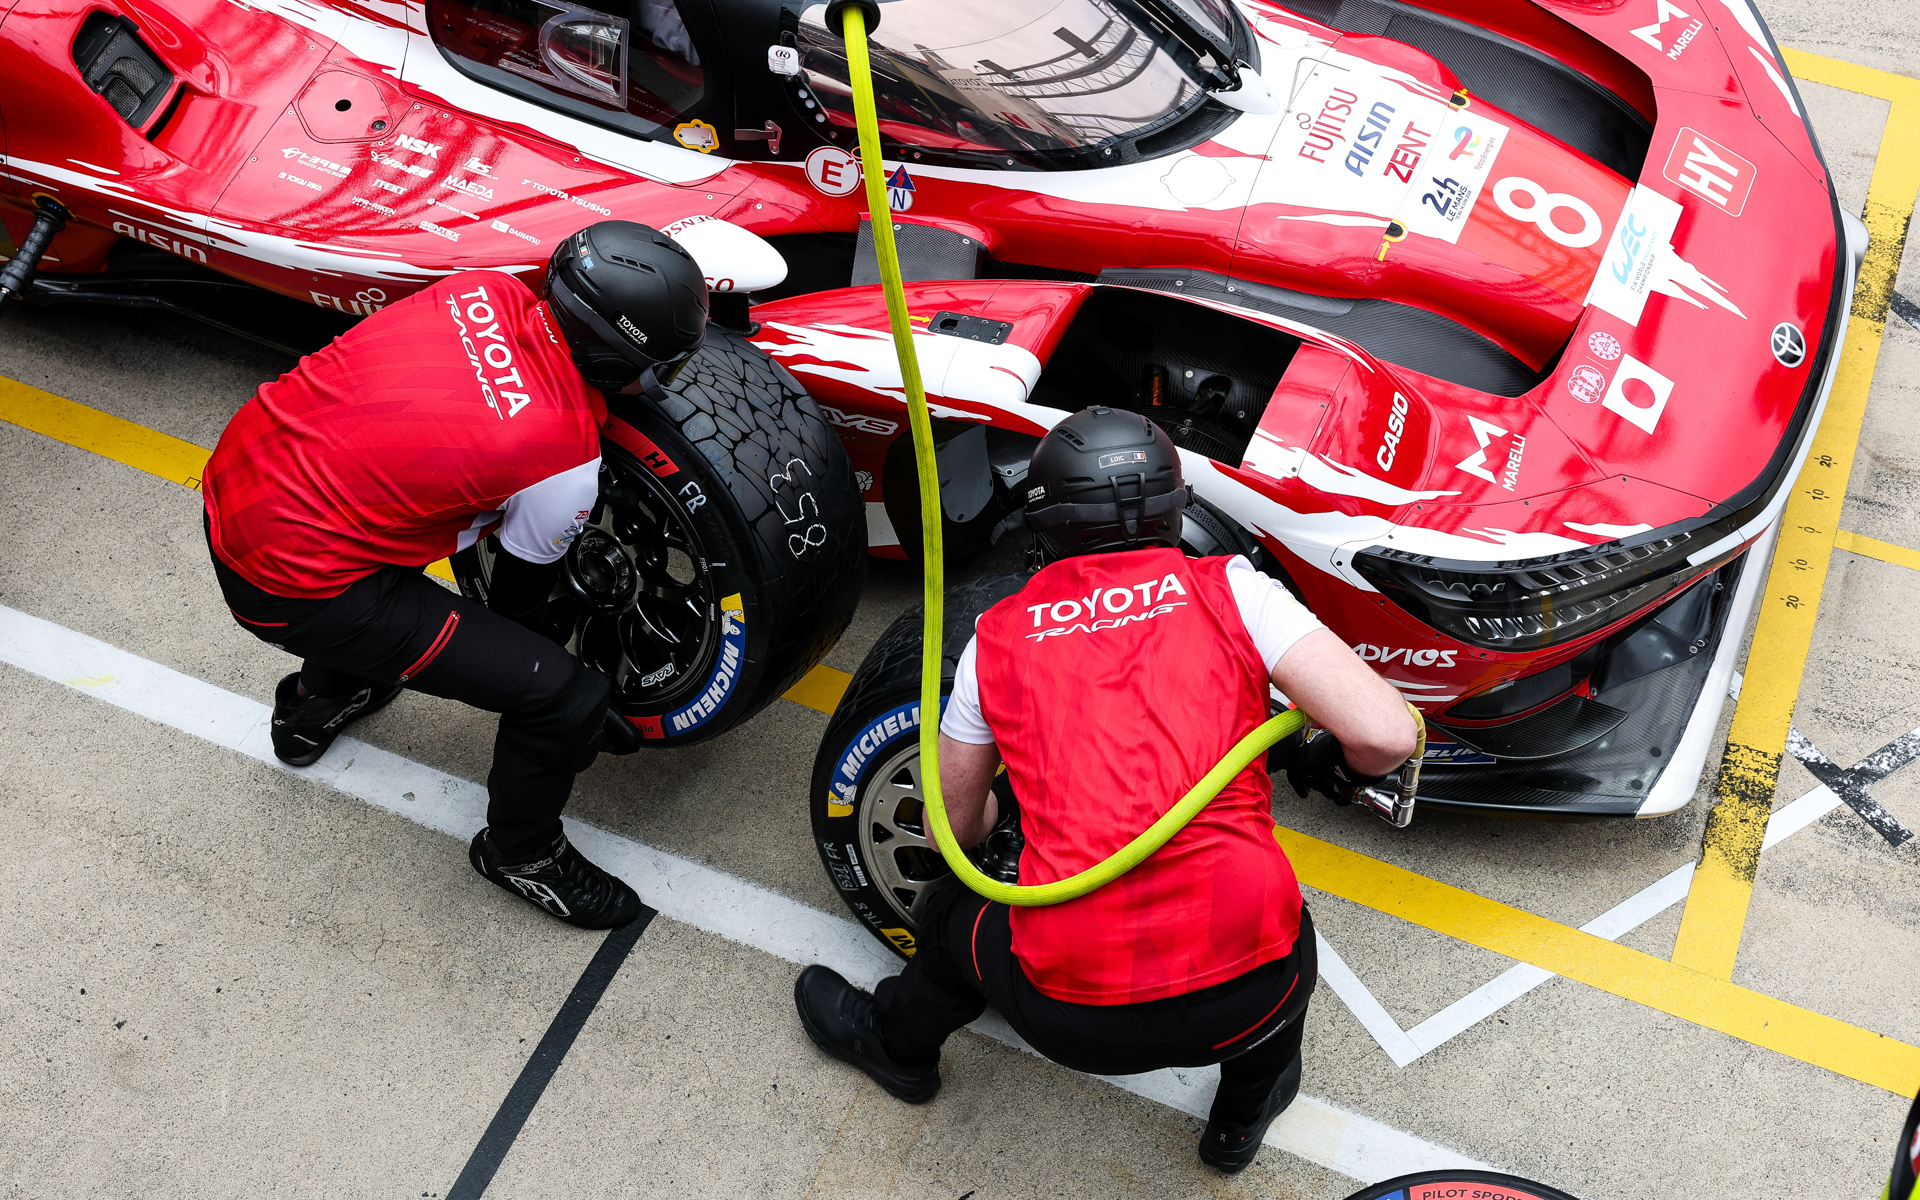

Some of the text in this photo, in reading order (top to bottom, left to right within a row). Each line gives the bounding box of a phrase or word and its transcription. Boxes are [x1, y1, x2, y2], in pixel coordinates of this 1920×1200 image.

[1666, 18, 1703, 61] MARELLI
[1298, 87, 1358, 164] FUJITSU
[1345, 101, 1396, 178] AISIN
[394, 134, 443, 159] NSK
[1383, 121, 1431, 184] ZENT
[1474, 137, 1496, 171] TotalEnergies
[286, 174, 308, 186] TOKAI
[297, 158, 348, 179] TOYOTA AUTO BODY
[821, 159, 844, 188] E
[1677, 136, 1740, 207] HY
[371, 178, 408, 195] JTEKT
[443, 174, 494, 199] MAEDA
[532, 181, 612, 217] TOYOTA TSUSHO
[892, 188, 906, 209] N
[1422, 176, 1460, 217] 24h
[1446, 185, 1468, 222] LE MANS
[351, 196, 397, 215] NPR-RIKEN
[435, 201, 460, 213] TOYODA
[1493, 176, 1602, 248] 8
[112, 221, 208, 264] AISIN
[420, 220, 461, 239] GENTEX
[508, 227, 541, 246] DAIHATSU
[1612, 212, 1647, 285] WEC
[1630, 230, 1659, 291] FIA WORLD ENDURANCE
[1637, 253, 1656, 294] CHAMPIONSHIP
[619, 314, 648, 344] TOYOTA
[446, 293, 505, 421] RACING
[459, 285, 532, 418] TOYOTA
[1376, 391, 1409, 472] CASIO
[643, 450, 669, 470] H
[1502, 433, 1527, 492] MARELLI
[1819, 454, 1833, 468] 20
[769, 457, 827, 559] 853
[1027, 485, 1046, 499] TOYOTA
[1811, 488, 1825, 500] 10
[1794, 558, 1808, 571] 10
[1026, 572, 1187, 628] TOYOTA
[1785, 595, 1800, 610] 20
[1025, 602, 1188, 642] RACING
[641, 662, 675, 687] RAYS
[672, 640, 740, 731] MICHELIN
[840, 702, 941, 782] MICHELI
[878, 851, 897, 884] TOYOTA
[1423, 1189, 1522, 1200] PILOT SPO
